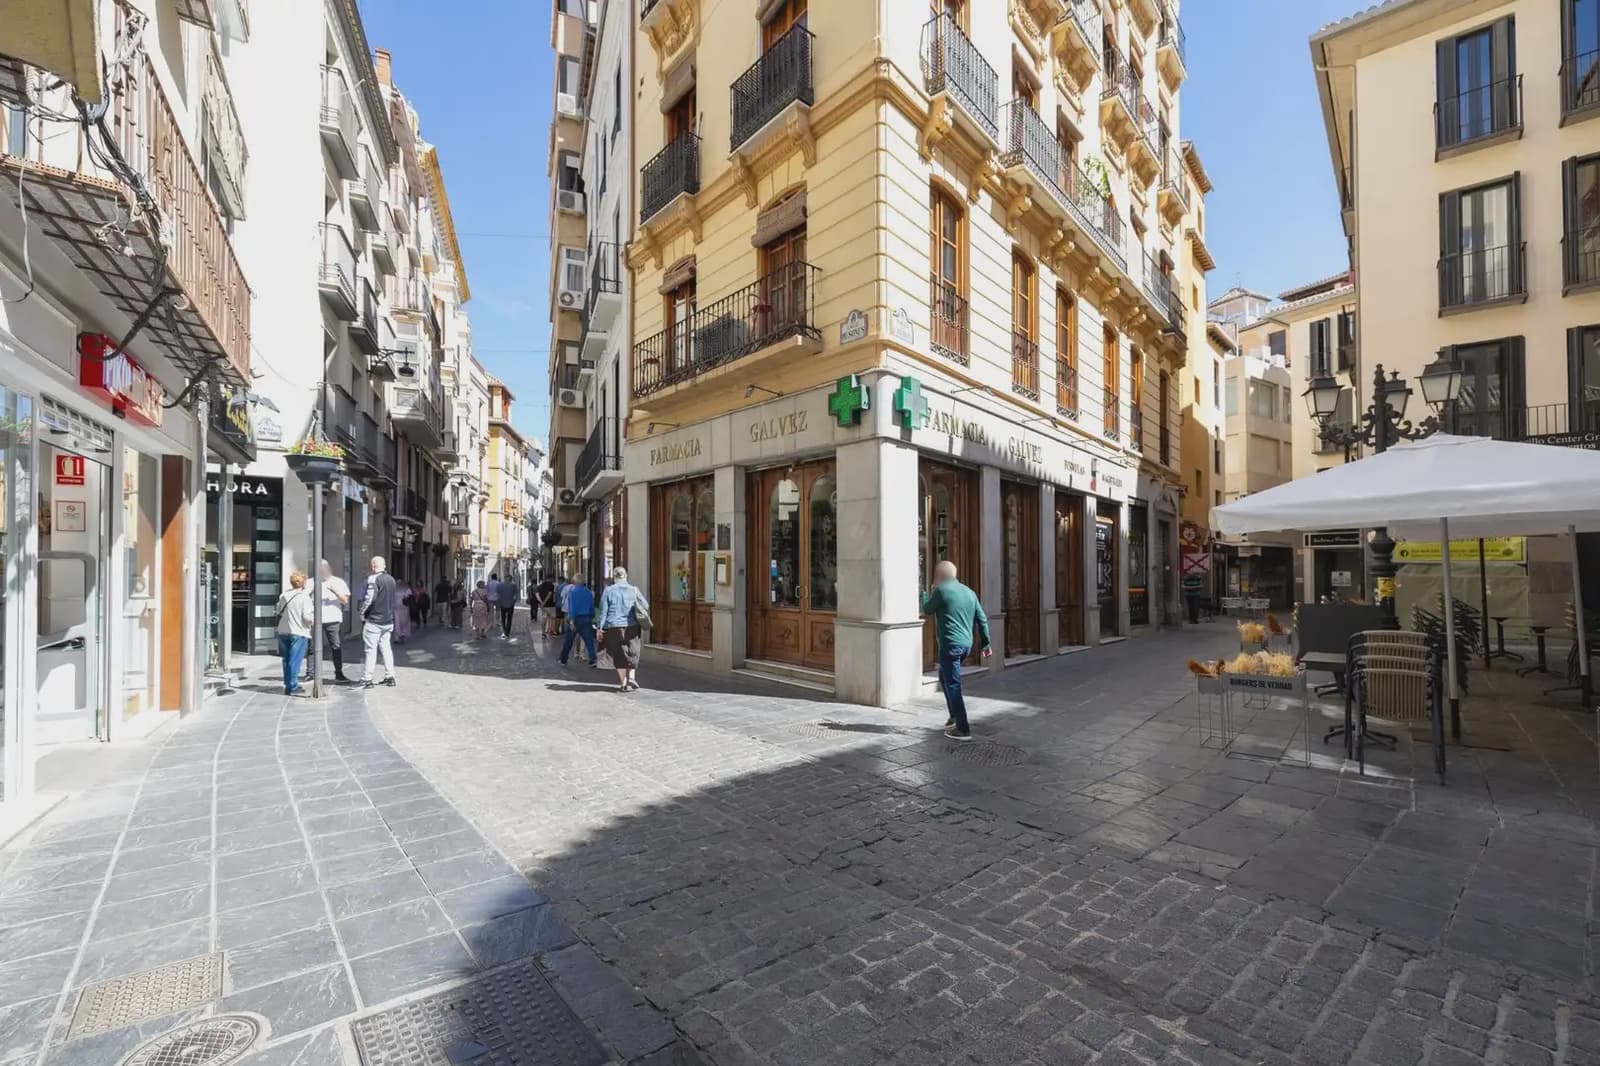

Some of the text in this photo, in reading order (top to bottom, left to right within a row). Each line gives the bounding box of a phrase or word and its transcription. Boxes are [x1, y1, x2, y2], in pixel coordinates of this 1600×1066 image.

[750, 411, 808, 443] GALVEZ
[924, 408, 1043, 464] FARMACIA GALVEZ
[650, 438, 702, 466] FARMACIA
